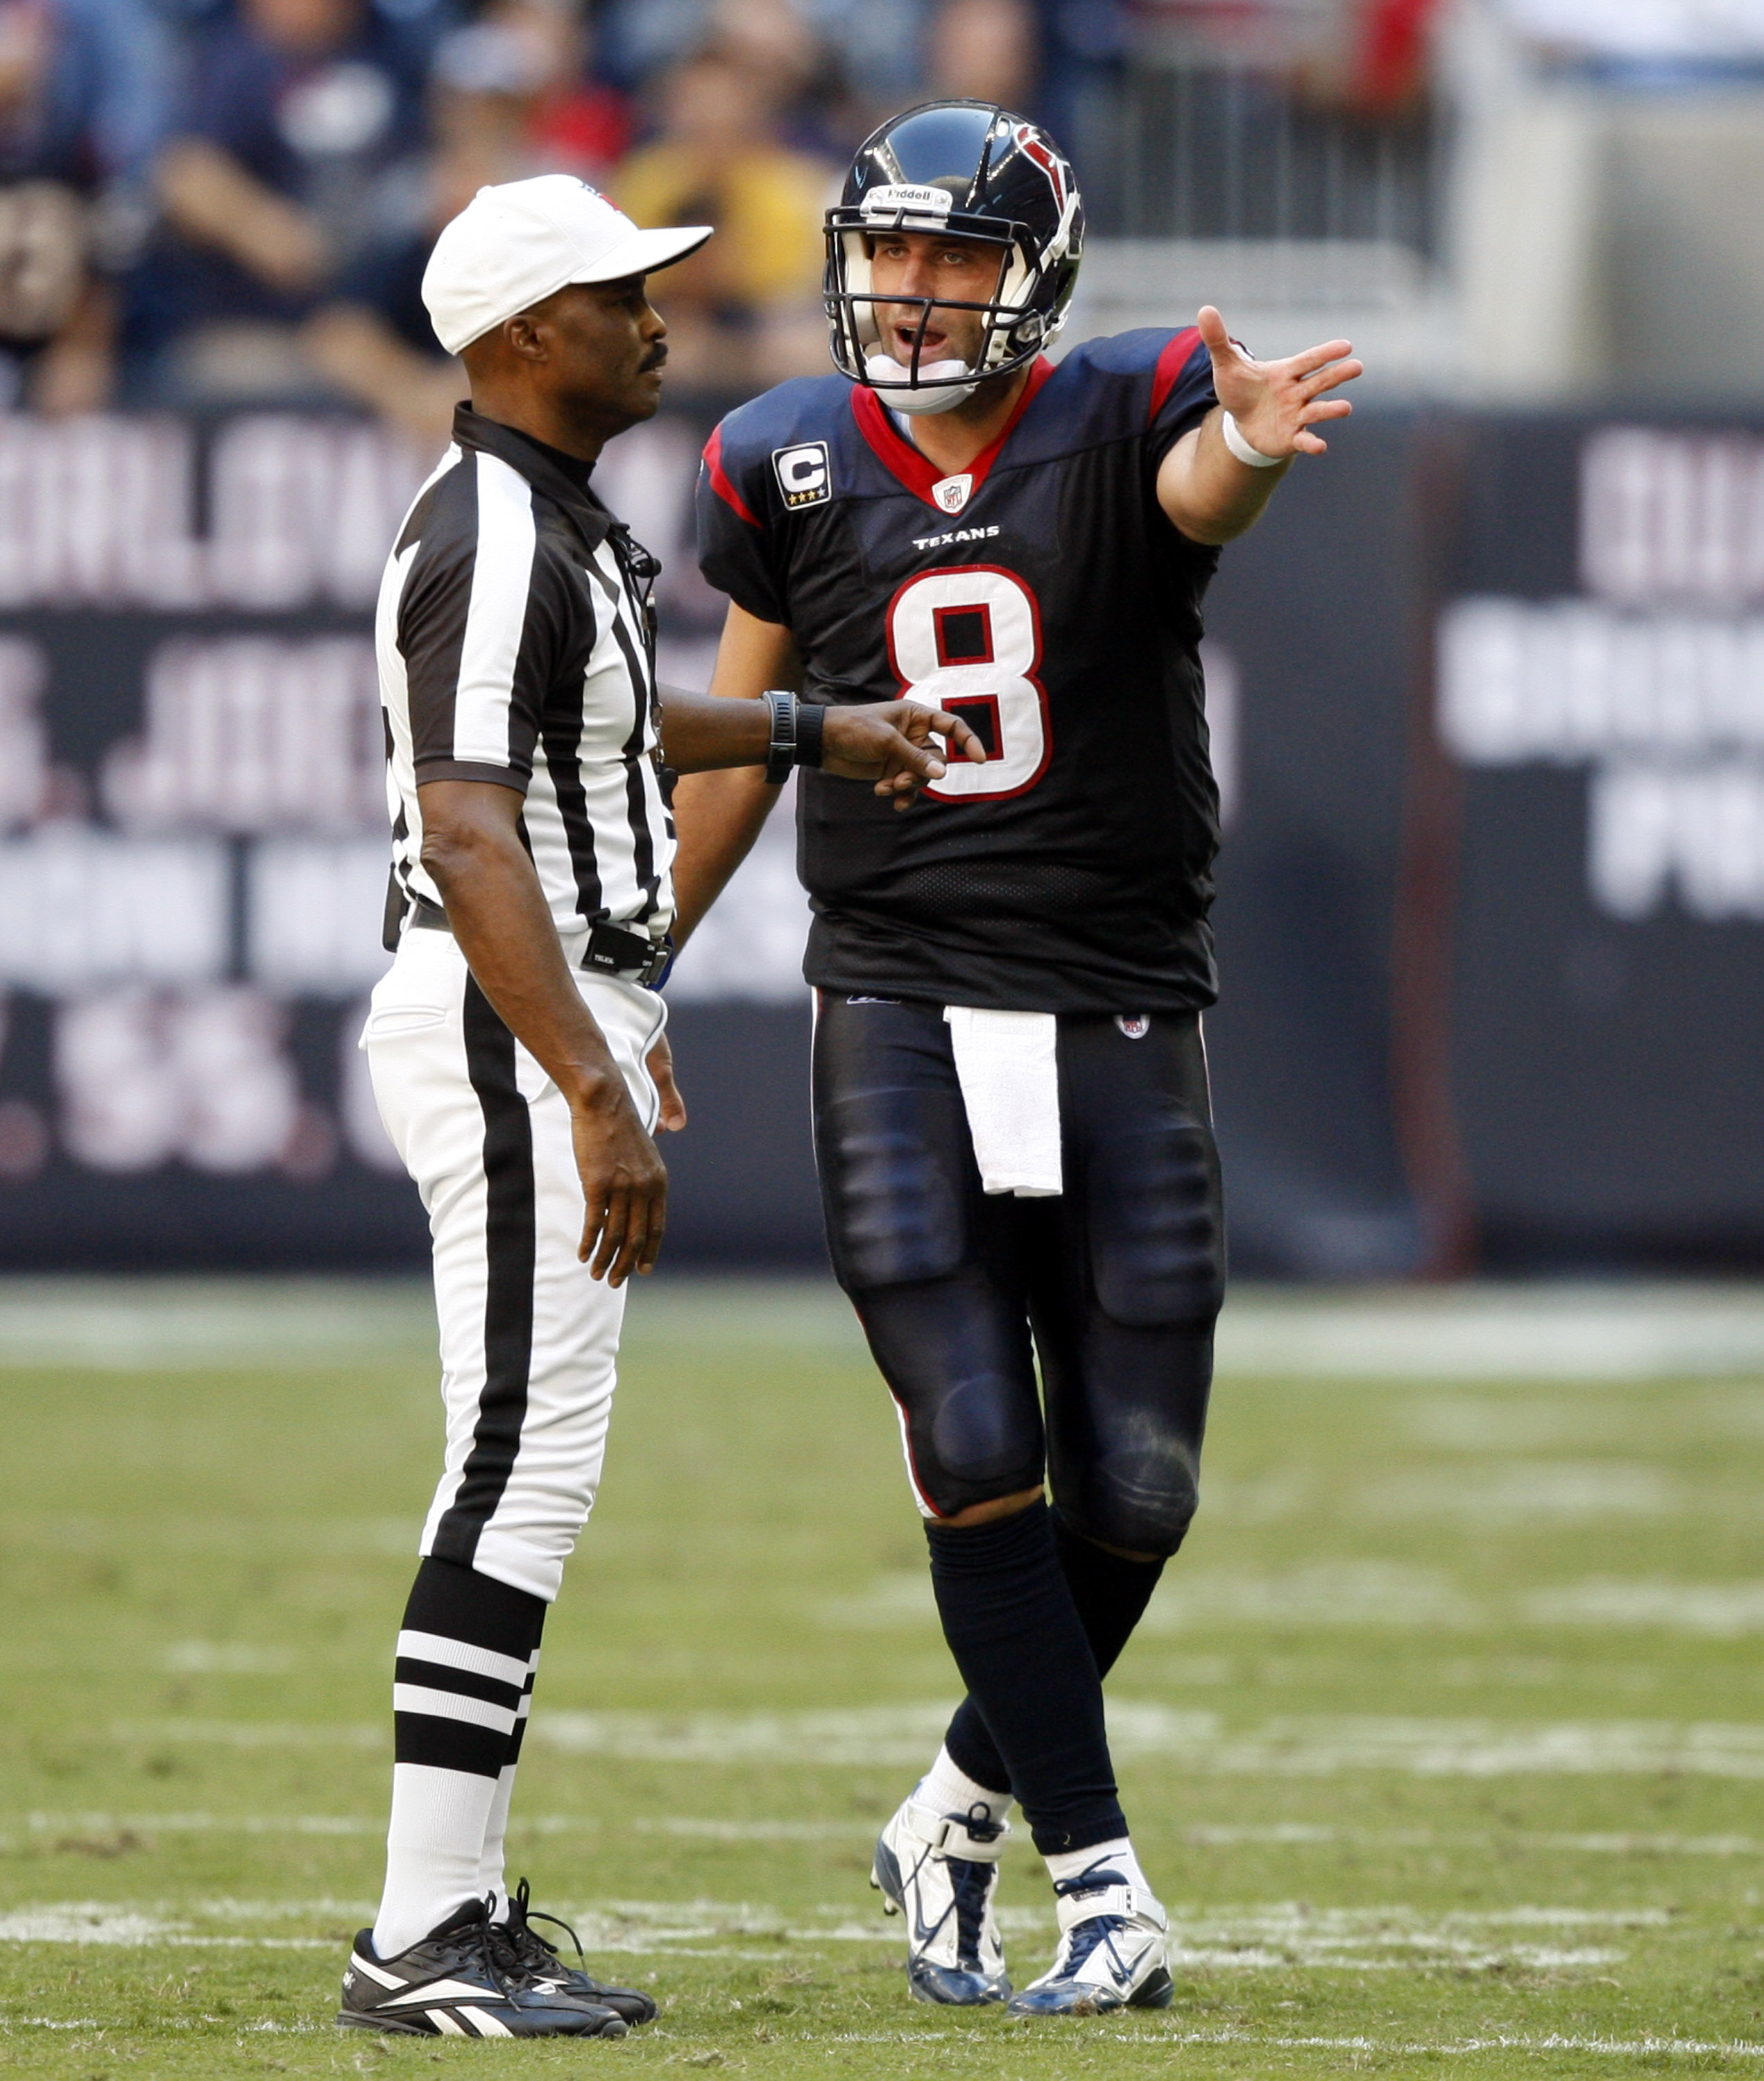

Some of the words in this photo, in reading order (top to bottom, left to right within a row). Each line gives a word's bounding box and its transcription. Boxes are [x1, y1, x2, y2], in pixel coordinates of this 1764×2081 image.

[778, 448, 825, 493] C
[911, 525, 1000, 550] TEXANS
[887, 565, 1052, 803] 8
